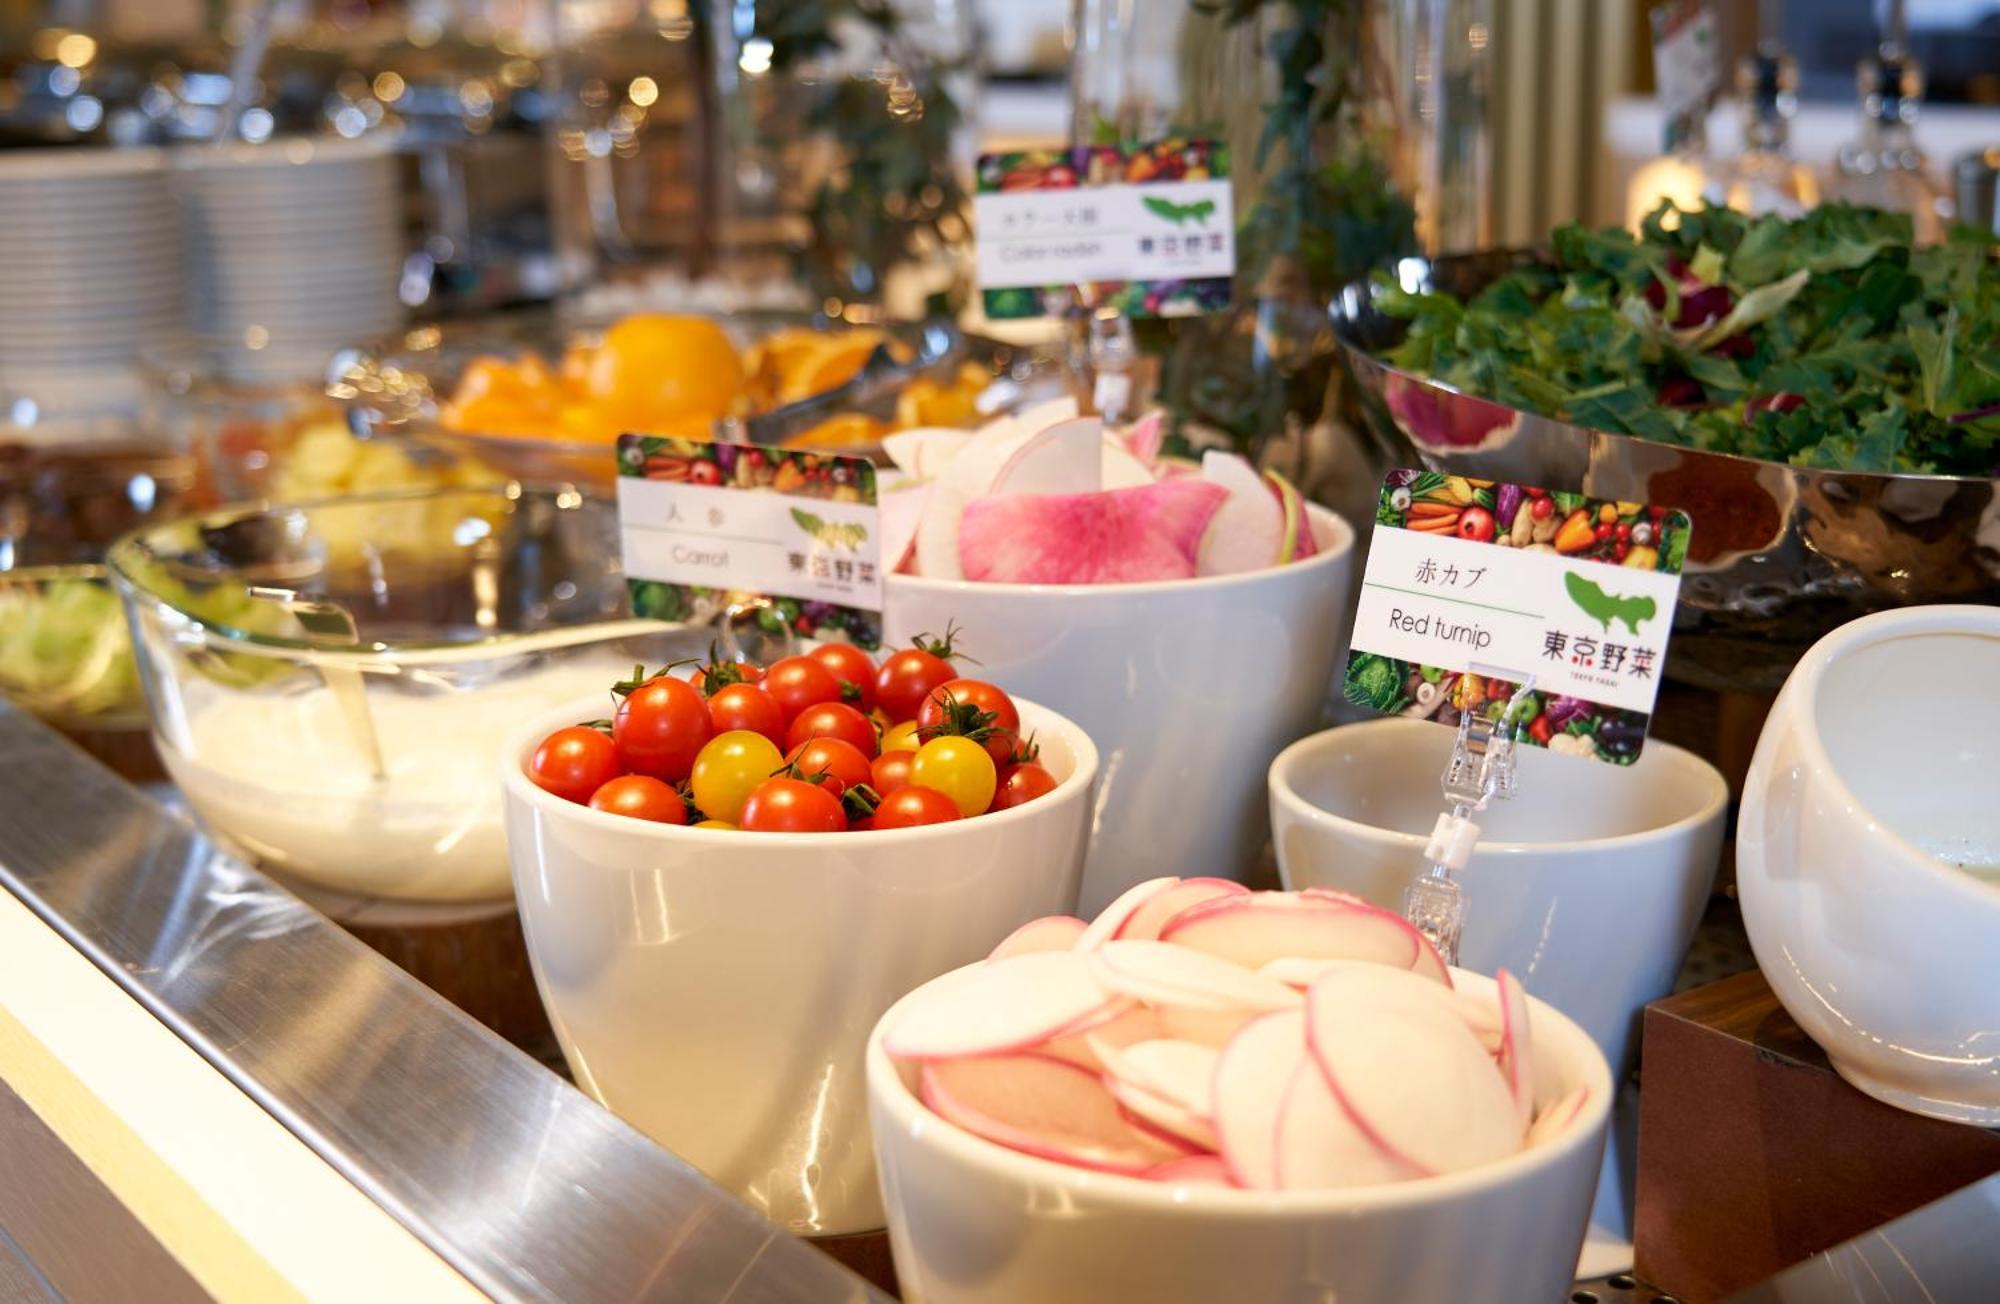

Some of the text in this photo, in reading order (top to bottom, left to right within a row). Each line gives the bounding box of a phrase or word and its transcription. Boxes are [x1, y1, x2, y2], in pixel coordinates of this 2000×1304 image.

[671, 544, 730, 567] Carrot
[1414, 558, 1487, 589] 赤カブ
[1389, 607, 1491, 651] Red turnip
[1542, 630, 1657, 680] 東京野菜
